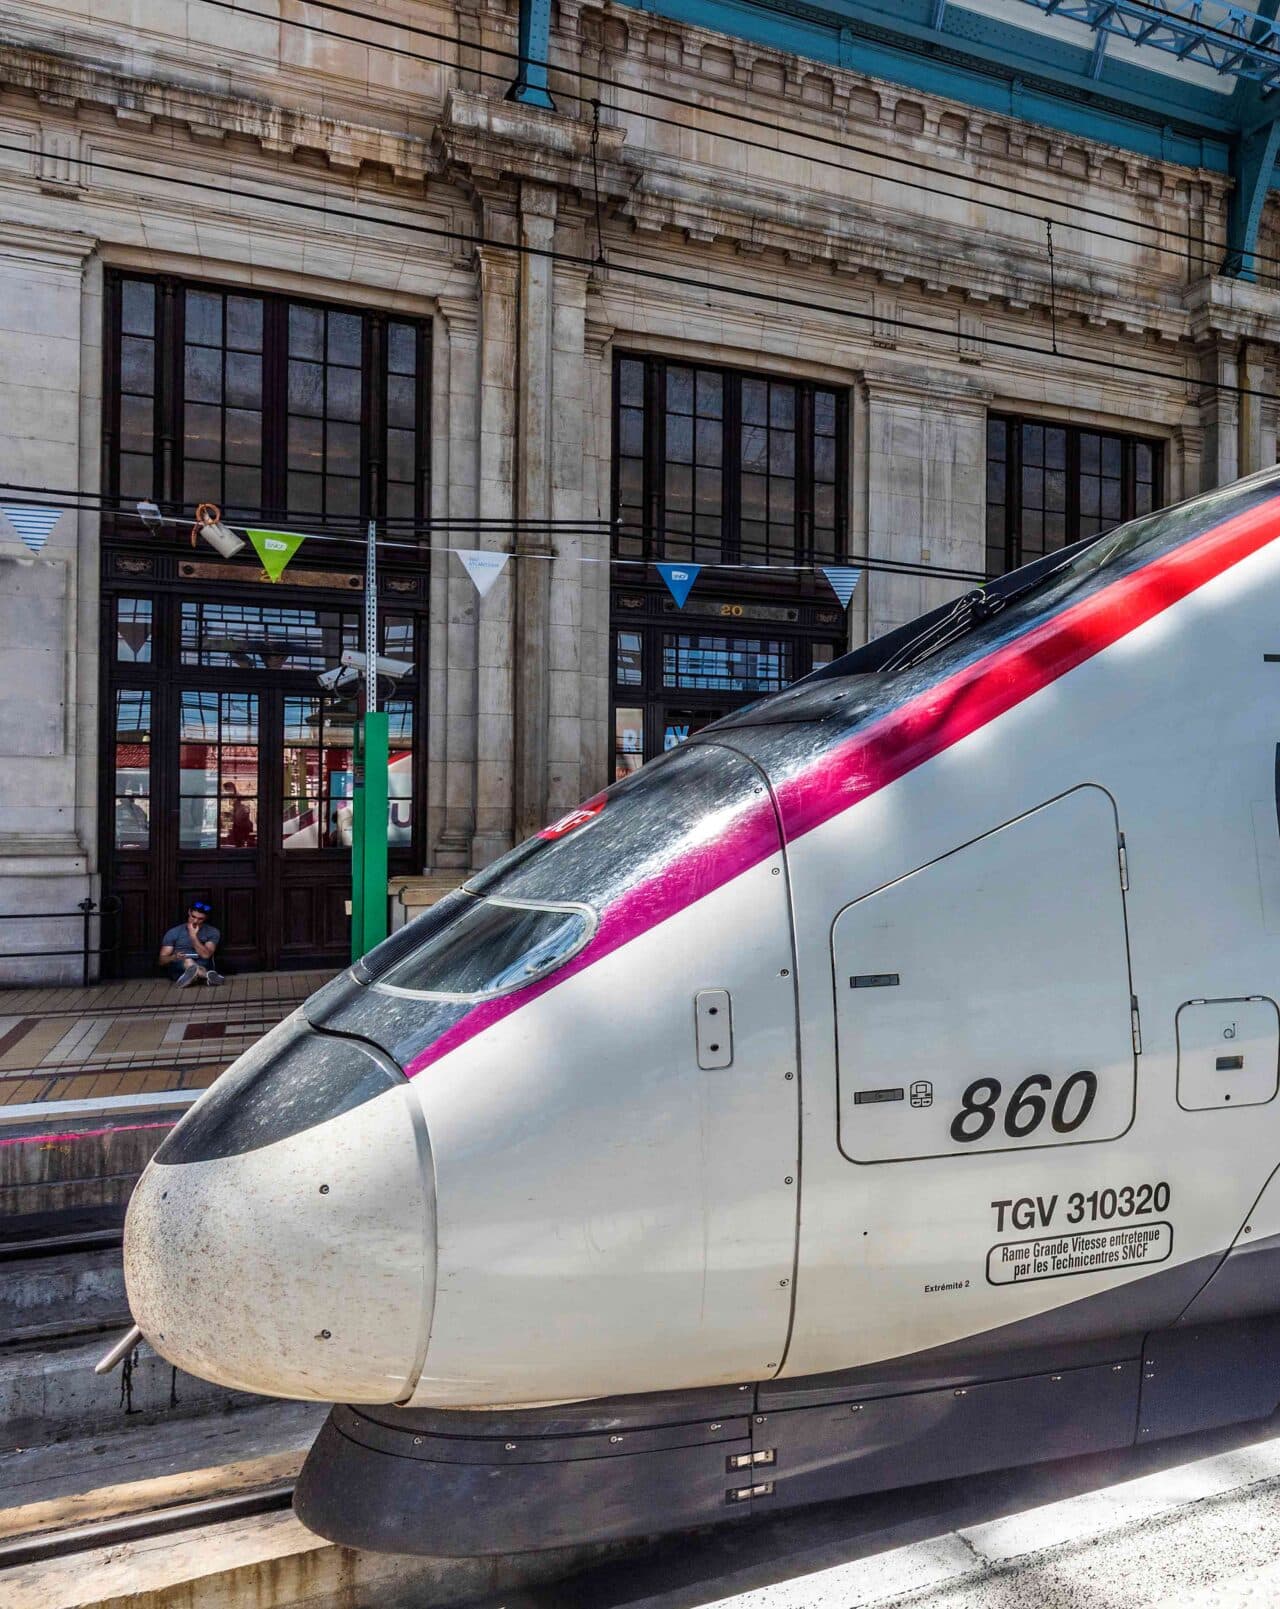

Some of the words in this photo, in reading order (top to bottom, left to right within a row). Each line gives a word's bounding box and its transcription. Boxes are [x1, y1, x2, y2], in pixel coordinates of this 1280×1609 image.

[720, 604, 743, 616] 20
[623, 725, 690, 752] RAY
[950, 1070, 1097, 1142] 860
[990, 1194, 1058, 1232] TGV
[1066, 1181, 1171, 1224] 310320
[1001, 1246, 1030, 1262] Rame
[1033, 1242, 1069, 1259] Grande
[1071, 1236, 1107, 1253] Vitesse
[1109, 1228, 1160, 1248] entretenue
[1013, 1262, 1031, 1280] par
[1033, 1257, 1048, 1273] les
[1051, 1251, 1120, 1271] Technicentres
[1121, 1242, 1149, 1260] SNCF
[924, 1281, 963, 1293] Extrémité
[964, 1280, 970, 1288] 2
